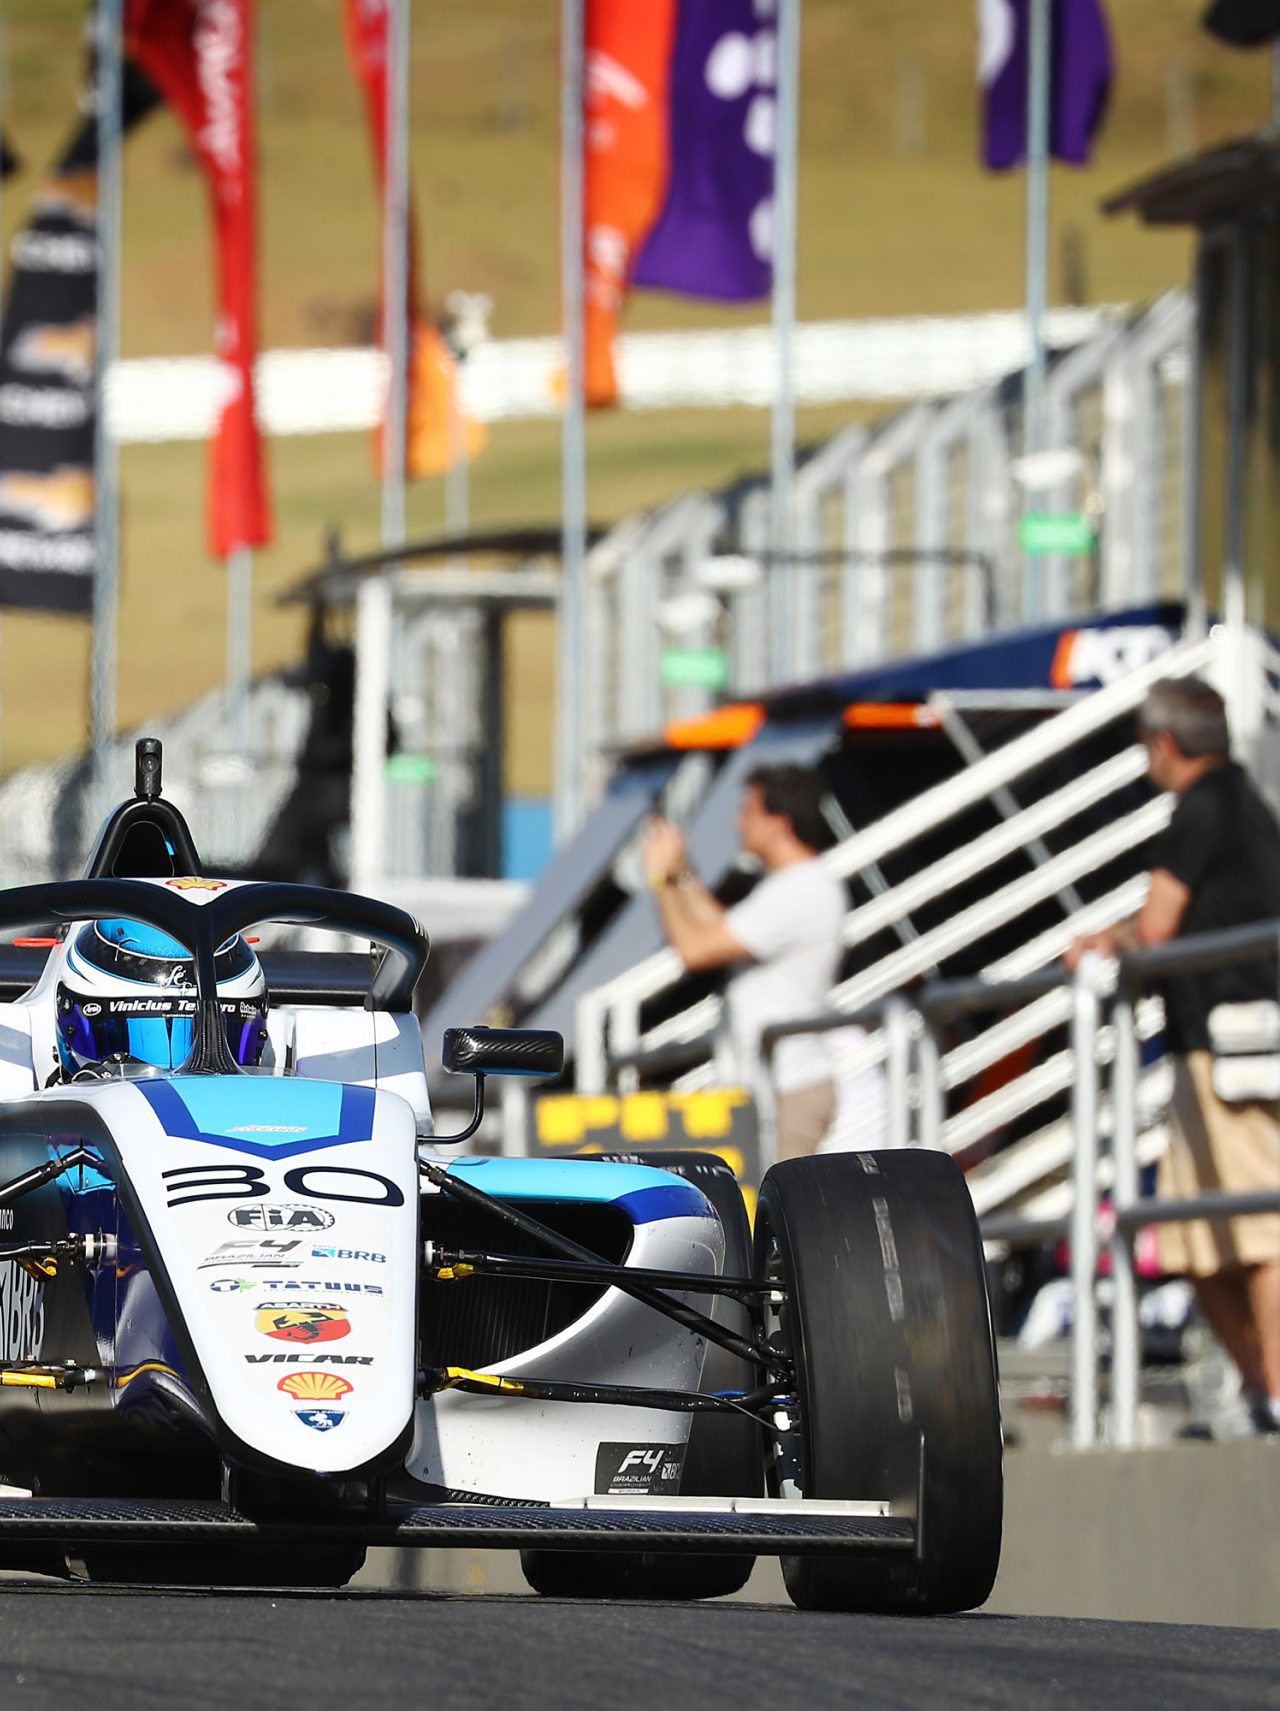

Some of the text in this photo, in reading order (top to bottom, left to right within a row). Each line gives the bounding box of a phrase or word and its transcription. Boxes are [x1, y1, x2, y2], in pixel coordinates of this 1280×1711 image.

[110, 999, 236, 1013] Vinicius Tero
[161, 1164, 405, 1208] 30
[210, 1239, 303, 1256] F4
[337, 1249, 387, 1263] BRB
[262, 1280, 384, 1294] TATUUS
[9, 1260, 46, 1362] BRB
[258, 1301, 344, 1311] ABARTH
[244, 1353, 374, 1366] VICAR
[618, 1450, 664, 1473] F4
